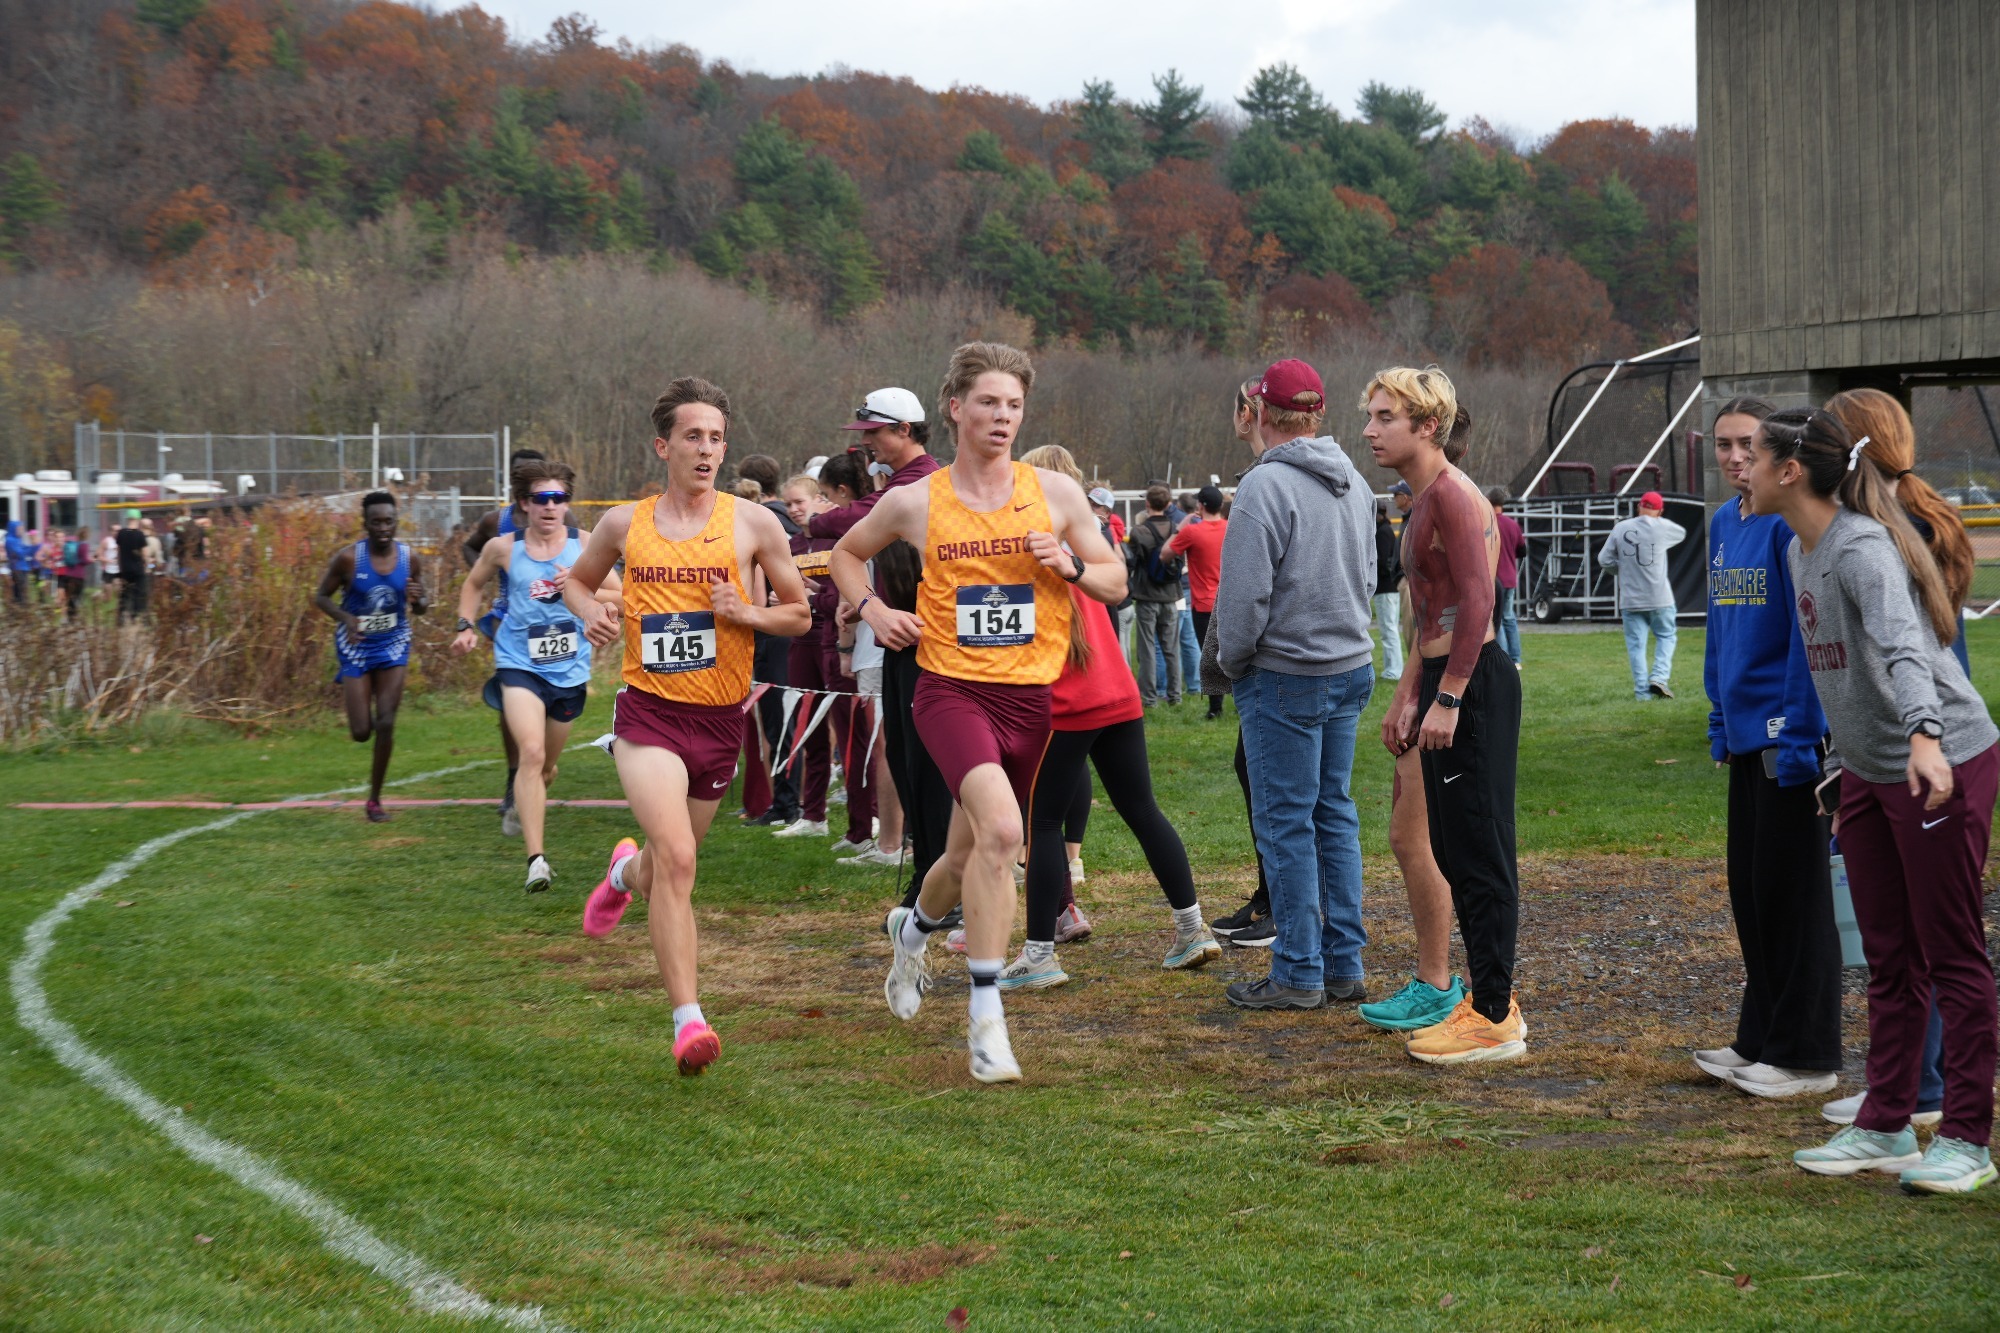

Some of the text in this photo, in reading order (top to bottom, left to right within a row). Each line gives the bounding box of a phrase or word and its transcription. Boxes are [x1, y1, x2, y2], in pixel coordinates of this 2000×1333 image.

[938, 536, 1031, 561] CHARLESTO
[1623, 530, 1654, 567] SU
[631, 567, 729, 584] CHARLESTON
[1749, 597, 1767, 605] HENS
[970, 609, 1022, 635] 154
[538, 637, 569, 656] 428
[653, 635, 704, 662] 145
[1807, 641, 1847, 671] DITION
[1007, 966, 1030, 978] HOKA
